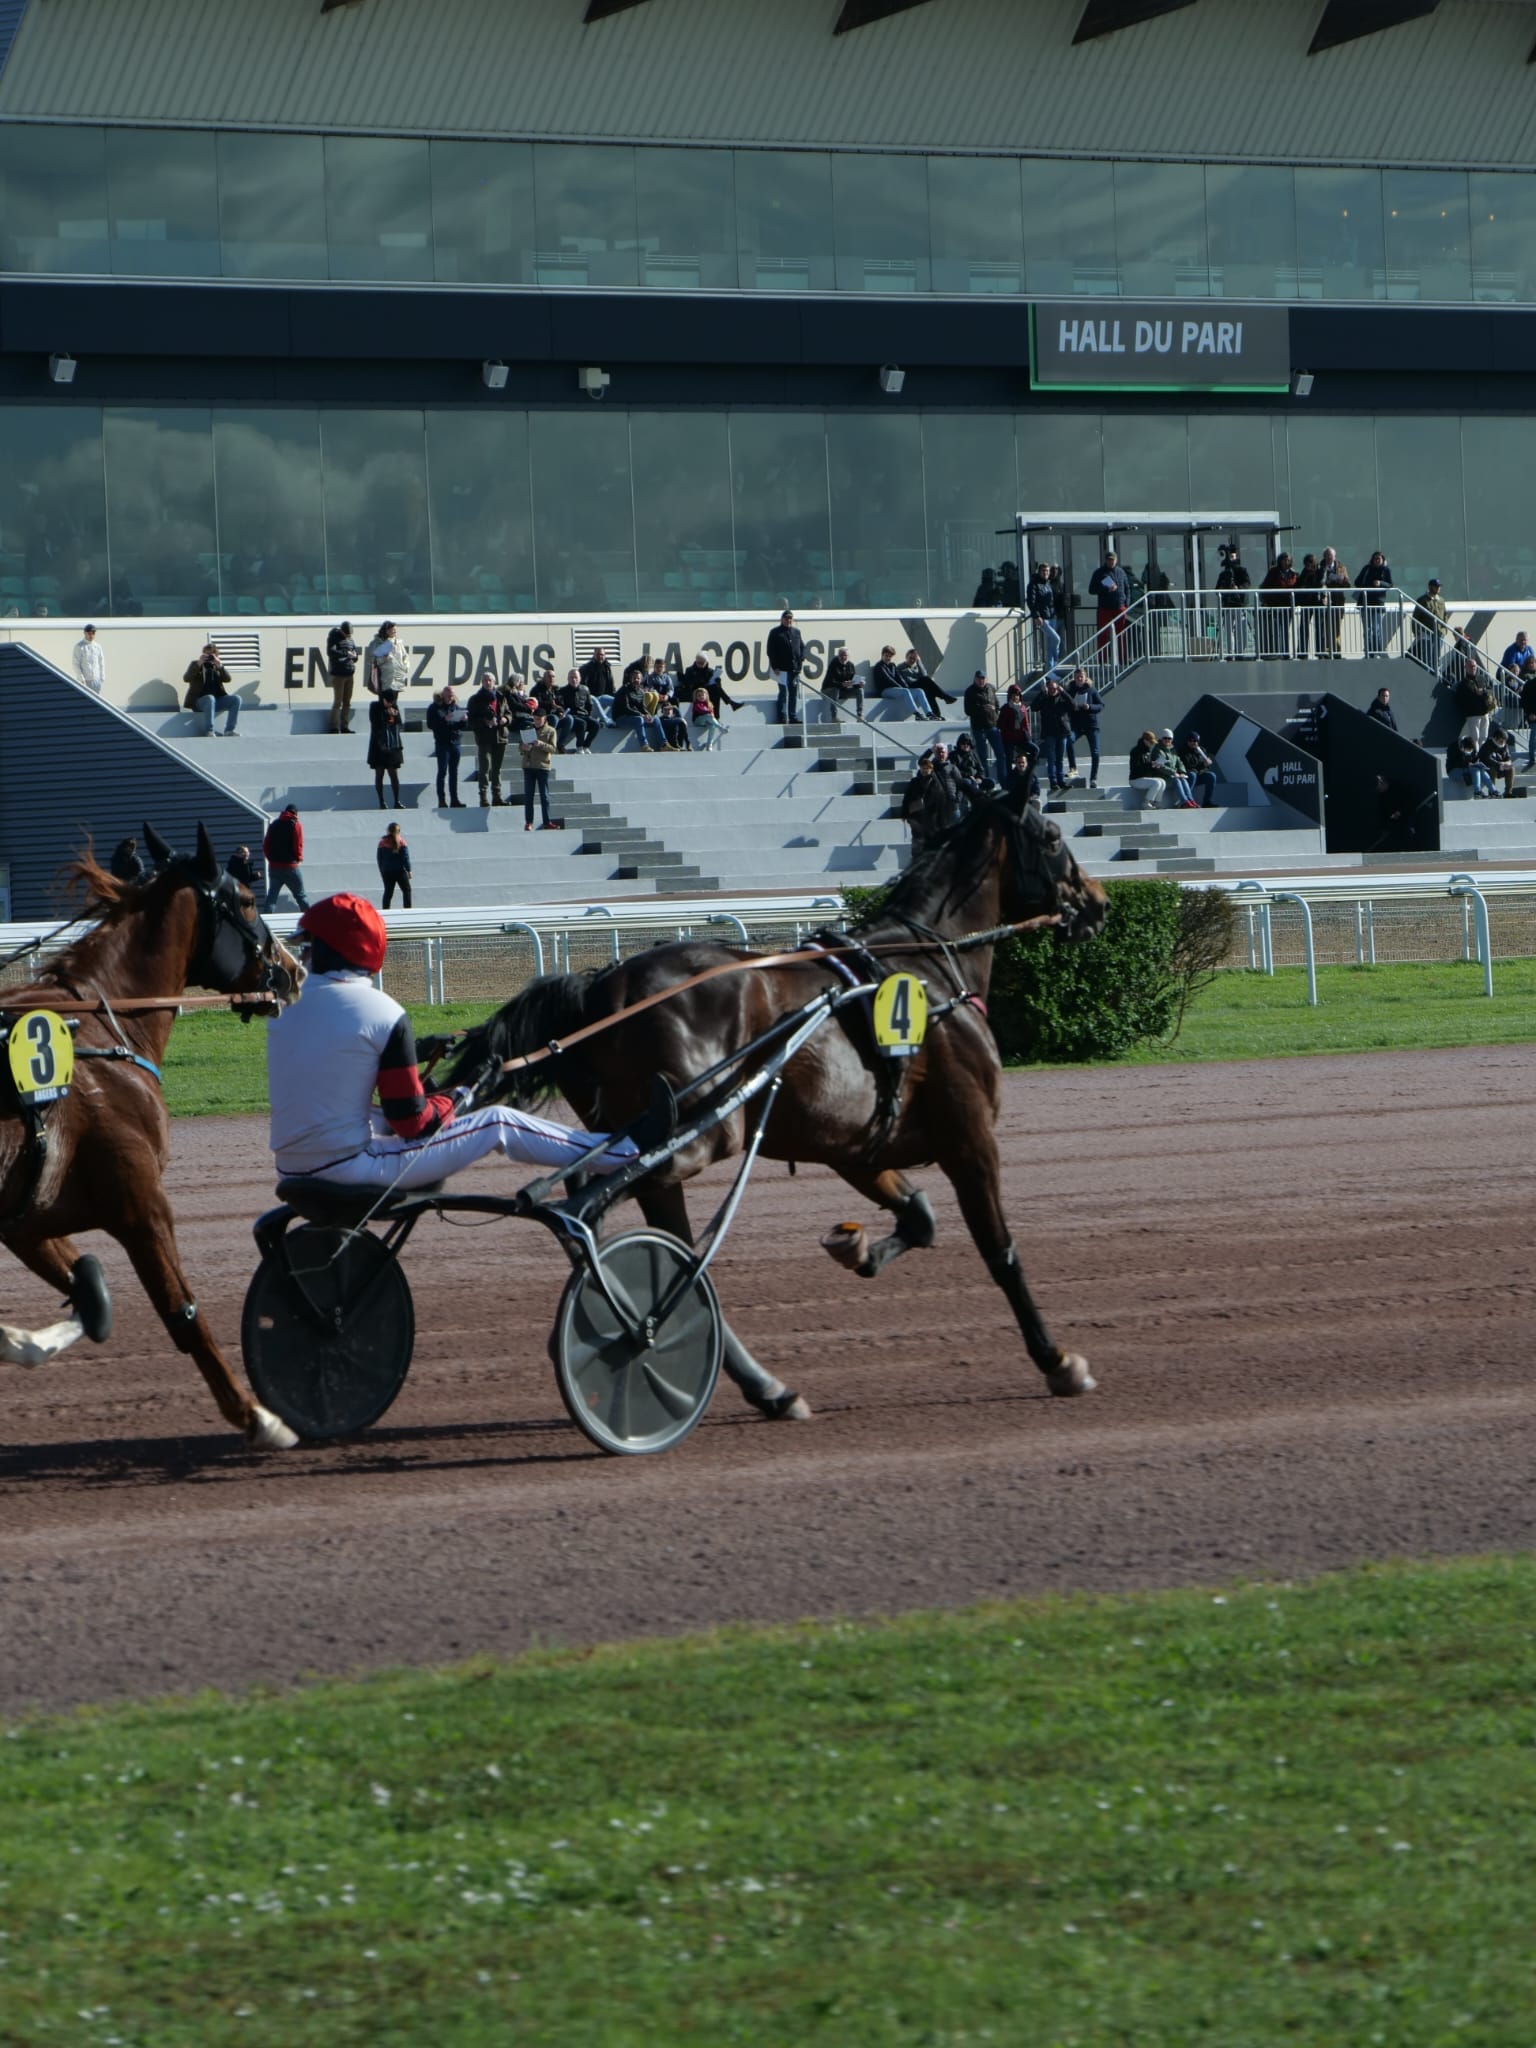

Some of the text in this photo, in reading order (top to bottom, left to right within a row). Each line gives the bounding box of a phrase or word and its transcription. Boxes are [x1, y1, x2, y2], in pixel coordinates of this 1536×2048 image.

[1058, 319, 1243, 354] HALL DU PARI
[284, 645, 435, 689] ENZ
[447, 643, 556, 686] DANS
[698, 639, 846, 681] OUS
[1282, 761, 1303, 772] HALL
[1282, 773, 1316, 785] DU PARI
[890, 979, 911, 1041] 4
[27, 1015, 55, 1086] 3
